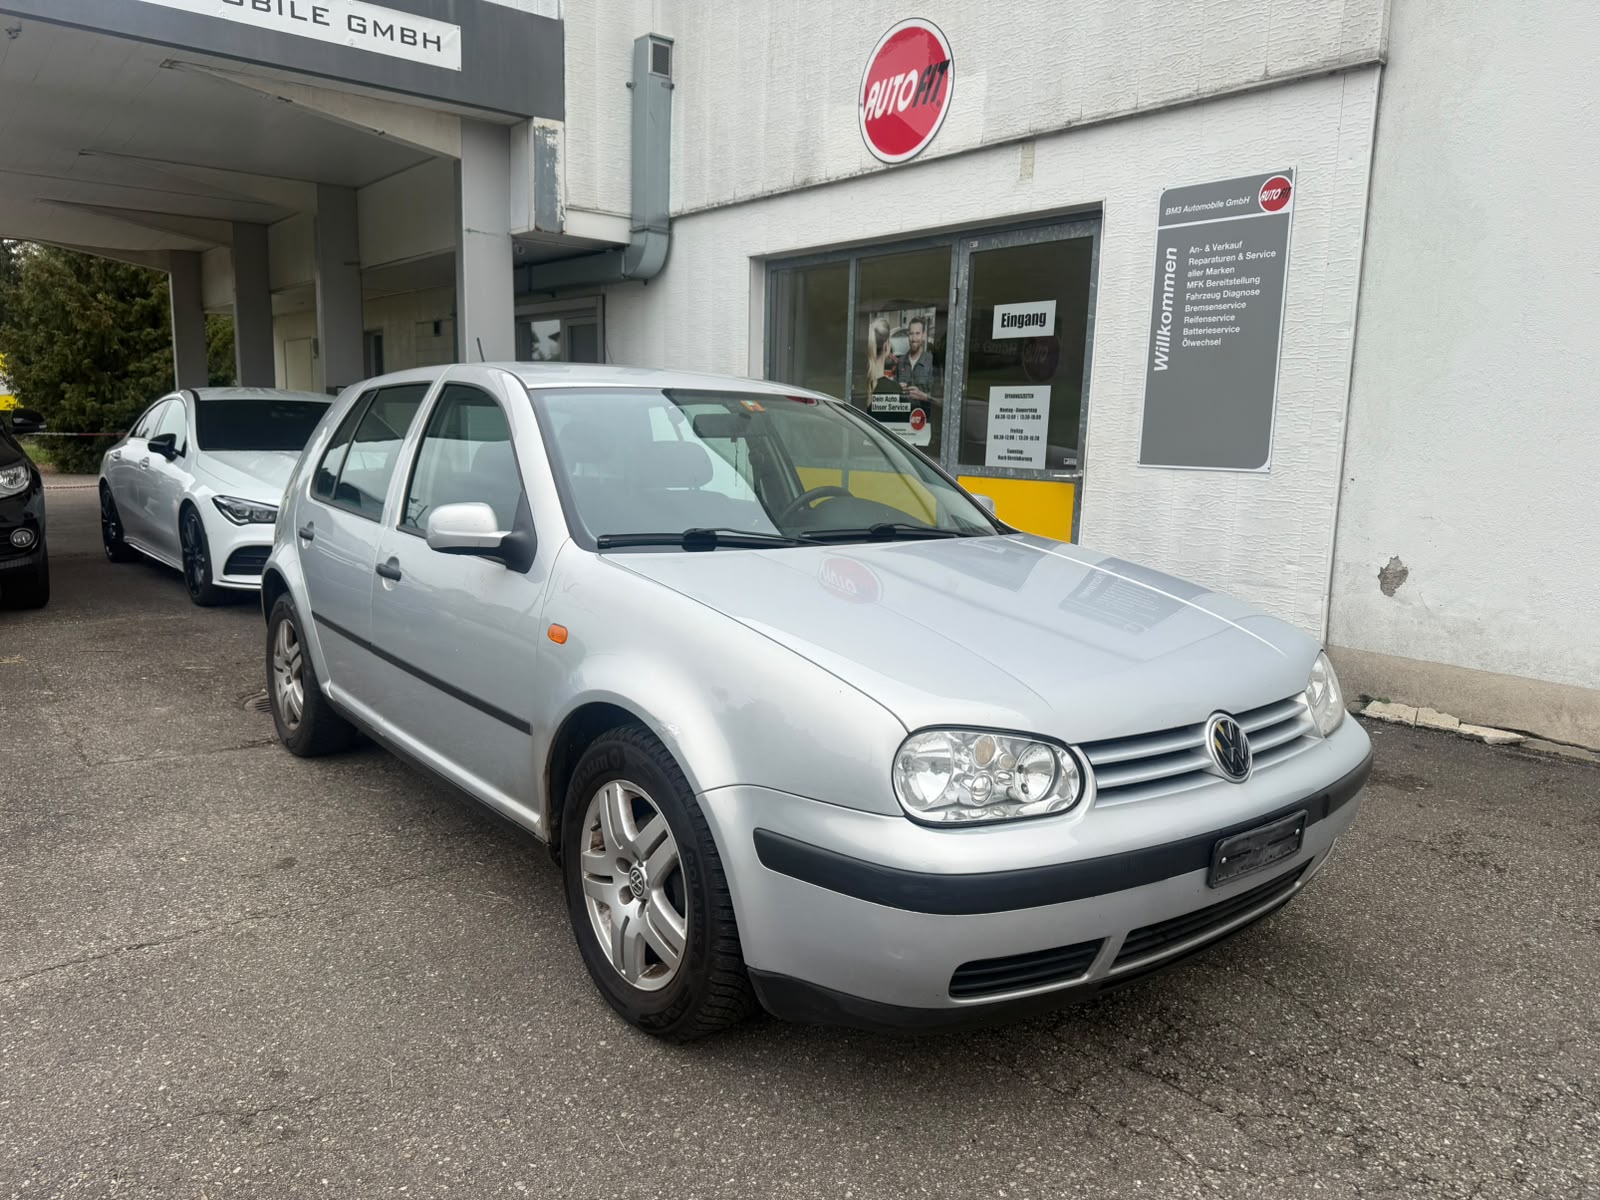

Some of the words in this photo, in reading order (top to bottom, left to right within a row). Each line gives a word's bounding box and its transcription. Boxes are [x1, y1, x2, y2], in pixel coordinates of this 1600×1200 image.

[221, 0, 330, 27] BILE
[347, 14, 441, 52] GMBH
[864, 59, 951, 121] AUTOFIT
[1165, 206, 1182, 216] BM3
[1183, 200, 1225, 213] Automobile
[1225, 196, 1251, 207] GmbH
[1189, 246, 1203, 255] An-
[1204, 244, 1211, 253] &
[1212, 241, 1243, 252] Verkauf
[1188, 254, 1236, 266] Reparaturen
[1237, 252, 1244, 261] &
[1245, 250, 1277, 260] Service
[1187, 269, 1204, 278] aller
[1205, 266, 1235, 276] Marken
[1186, 280, 1204, 289] MFK
[1206, 276, 1260, 287] Bereitstellung
[1185, 291, 1221, 301] Fahrzeug
[1222, 288, 1260, 299] Diagnose
[1153, 247, 1178, 372] Willkommen
[1184, 301, 1247, 312] Bremsenservice
[1001, 312, 1047, 329] Eingang
[1183, 314, 1236, 324] Reifenservice
[1182, 325, 1241, 336] Batterieservice
[1181, 338, 1222, 347] Ölwechsel
